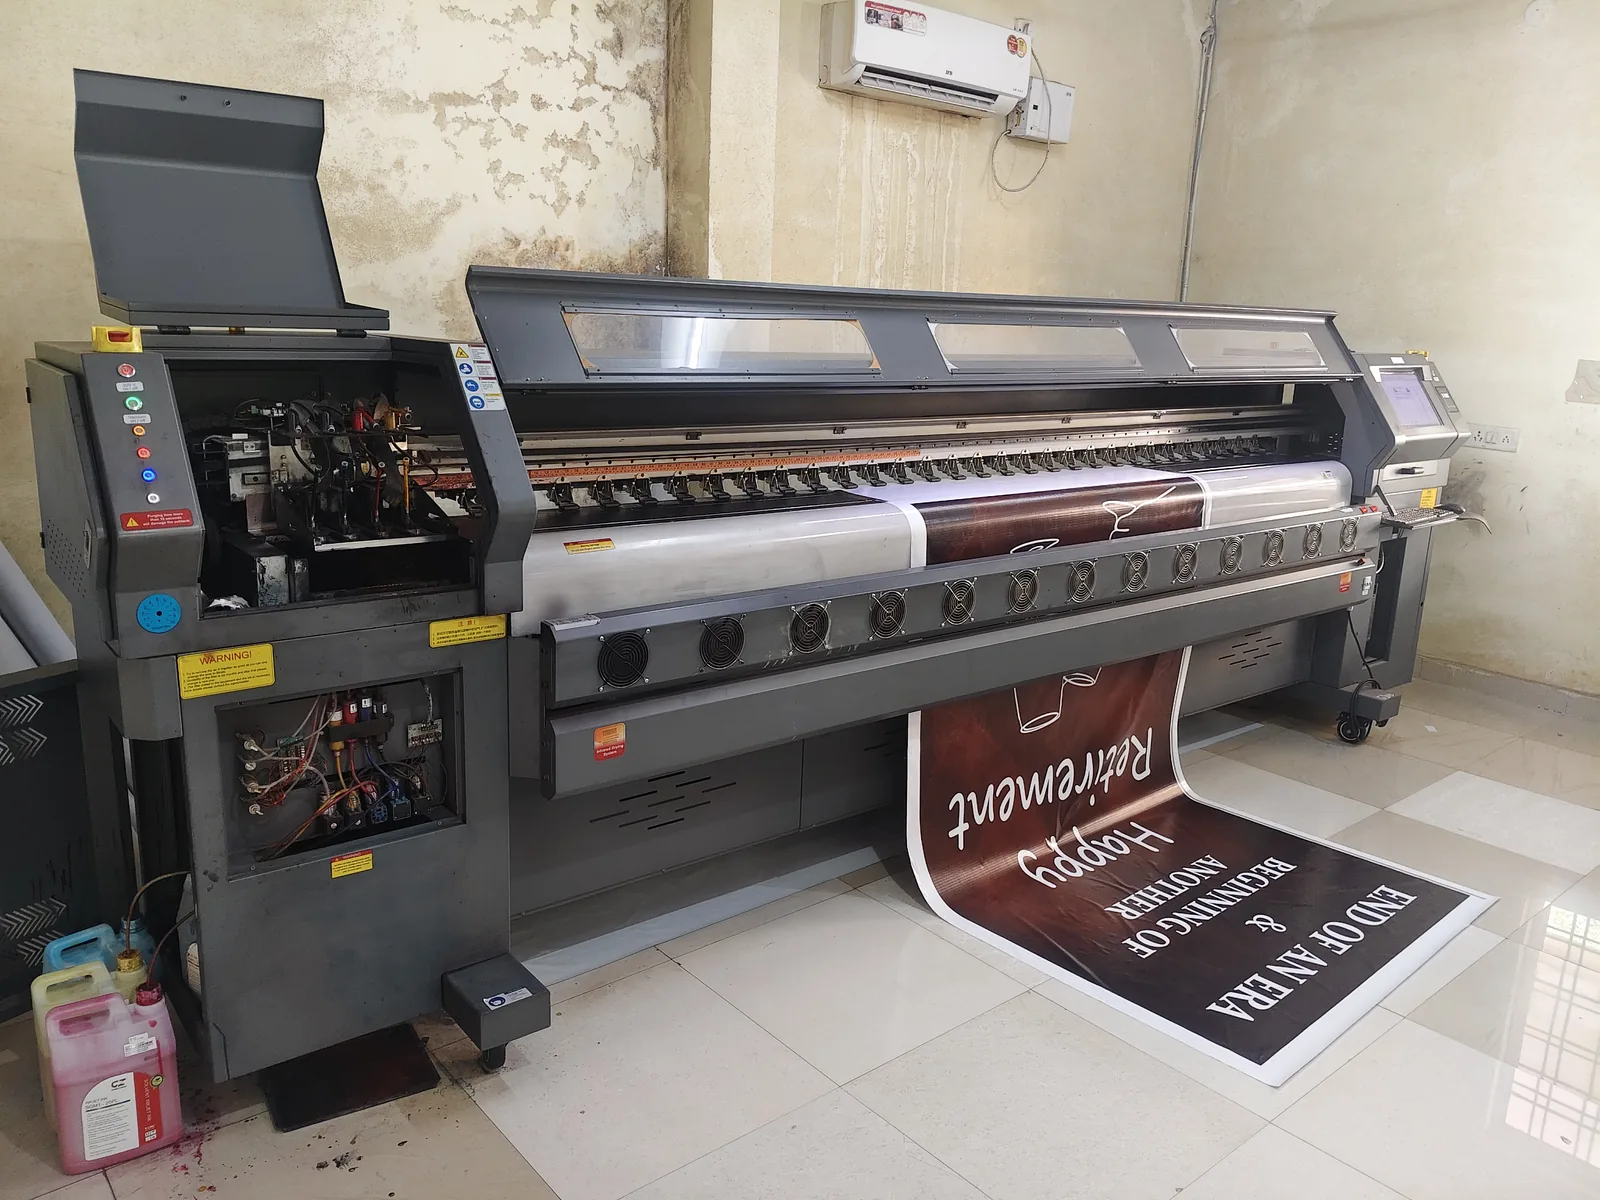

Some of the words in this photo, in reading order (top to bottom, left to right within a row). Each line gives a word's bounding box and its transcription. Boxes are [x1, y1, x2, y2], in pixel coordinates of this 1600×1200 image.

[199, 651, 252, 665] WARNING!
[948, 726, 1153, 851] Retirement
[1017, 821, 1175, 888] Happy
[1104, 854, 1228, 920] ANOTHER
[1156, 856, 1298, 936] BEGINNING
[1345, 884, 1418, 926] END
[1121, 929, 1171, 959] OF
[1245, 914, 1287, 933] &
[1308, 921, 1365, 956] OF
[1266, 943, 1328, 985] AN
[1205, 972, 1295, 1022] ERA
